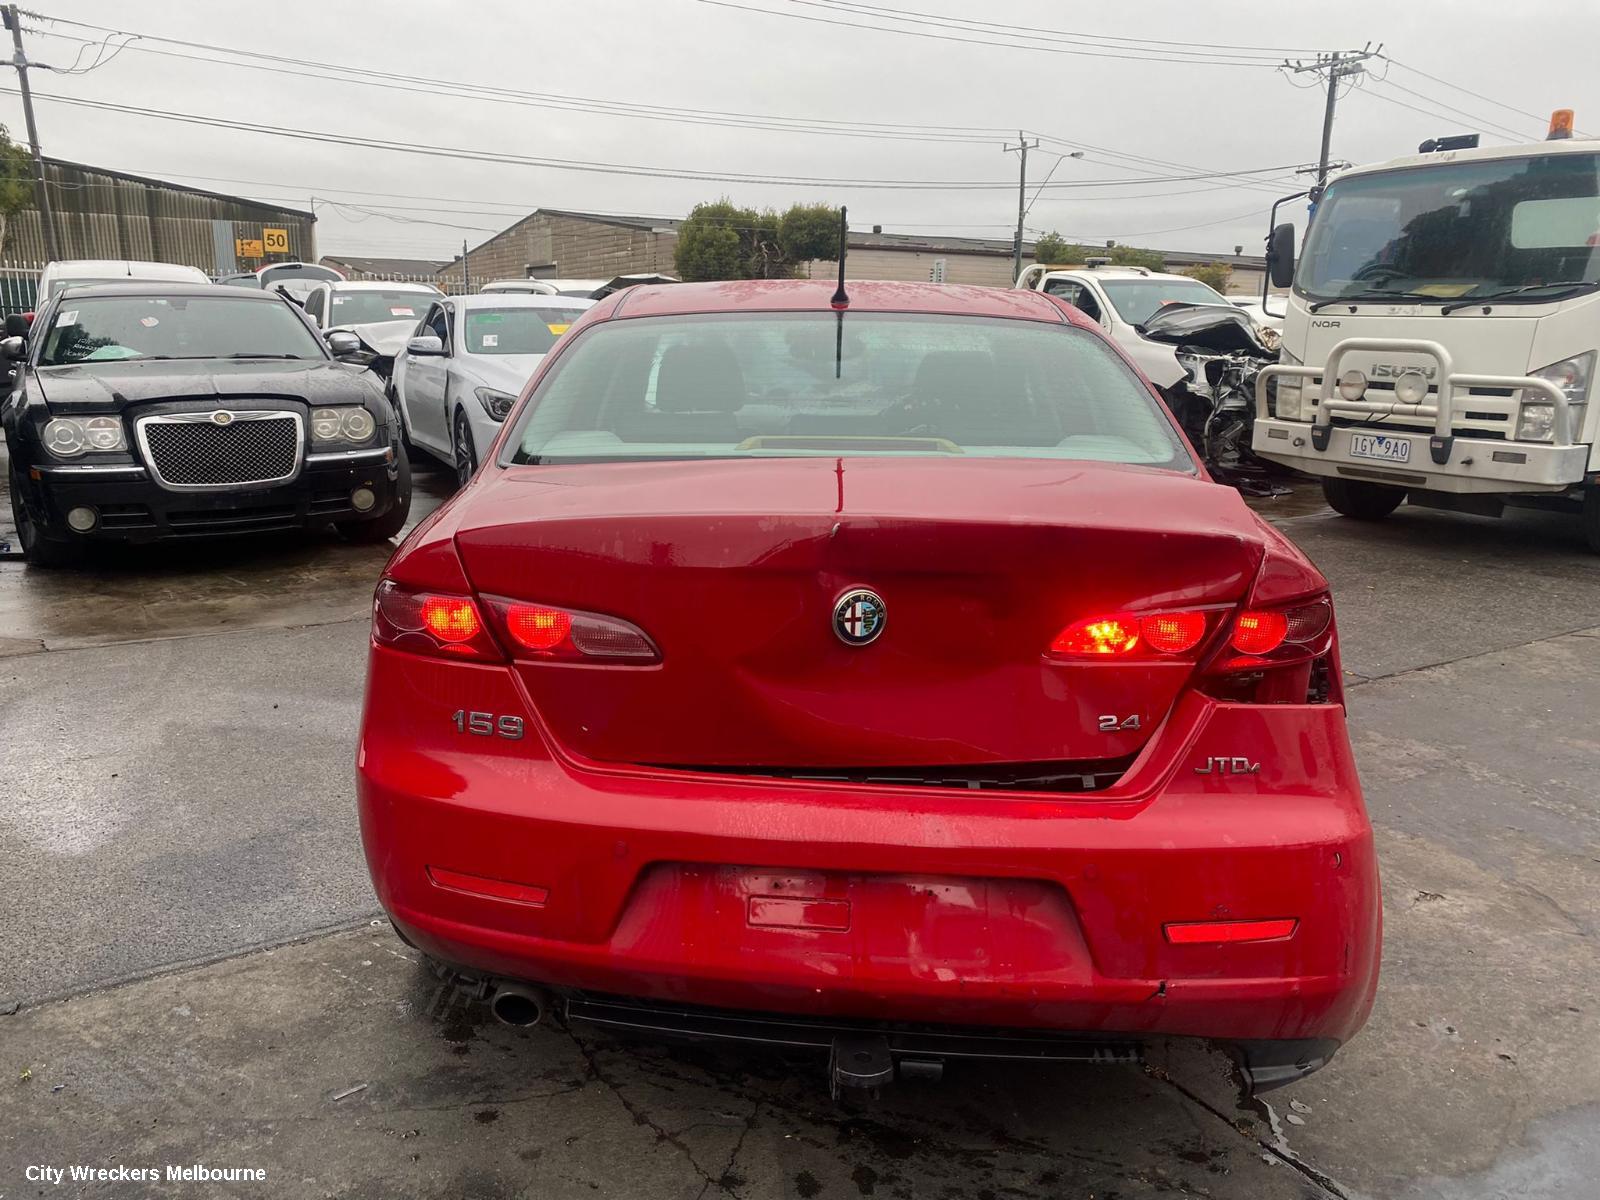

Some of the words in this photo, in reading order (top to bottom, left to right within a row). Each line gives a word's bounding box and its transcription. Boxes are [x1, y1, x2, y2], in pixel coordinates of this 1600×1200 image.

[267, 233, 285, 247] 50
[1354, 437, 1376, 453] 1GY
[838, 598, 855, 622] ALFA
[860, 594, 884, 618] ROMEO
[452, 709, 523, 740] 159
